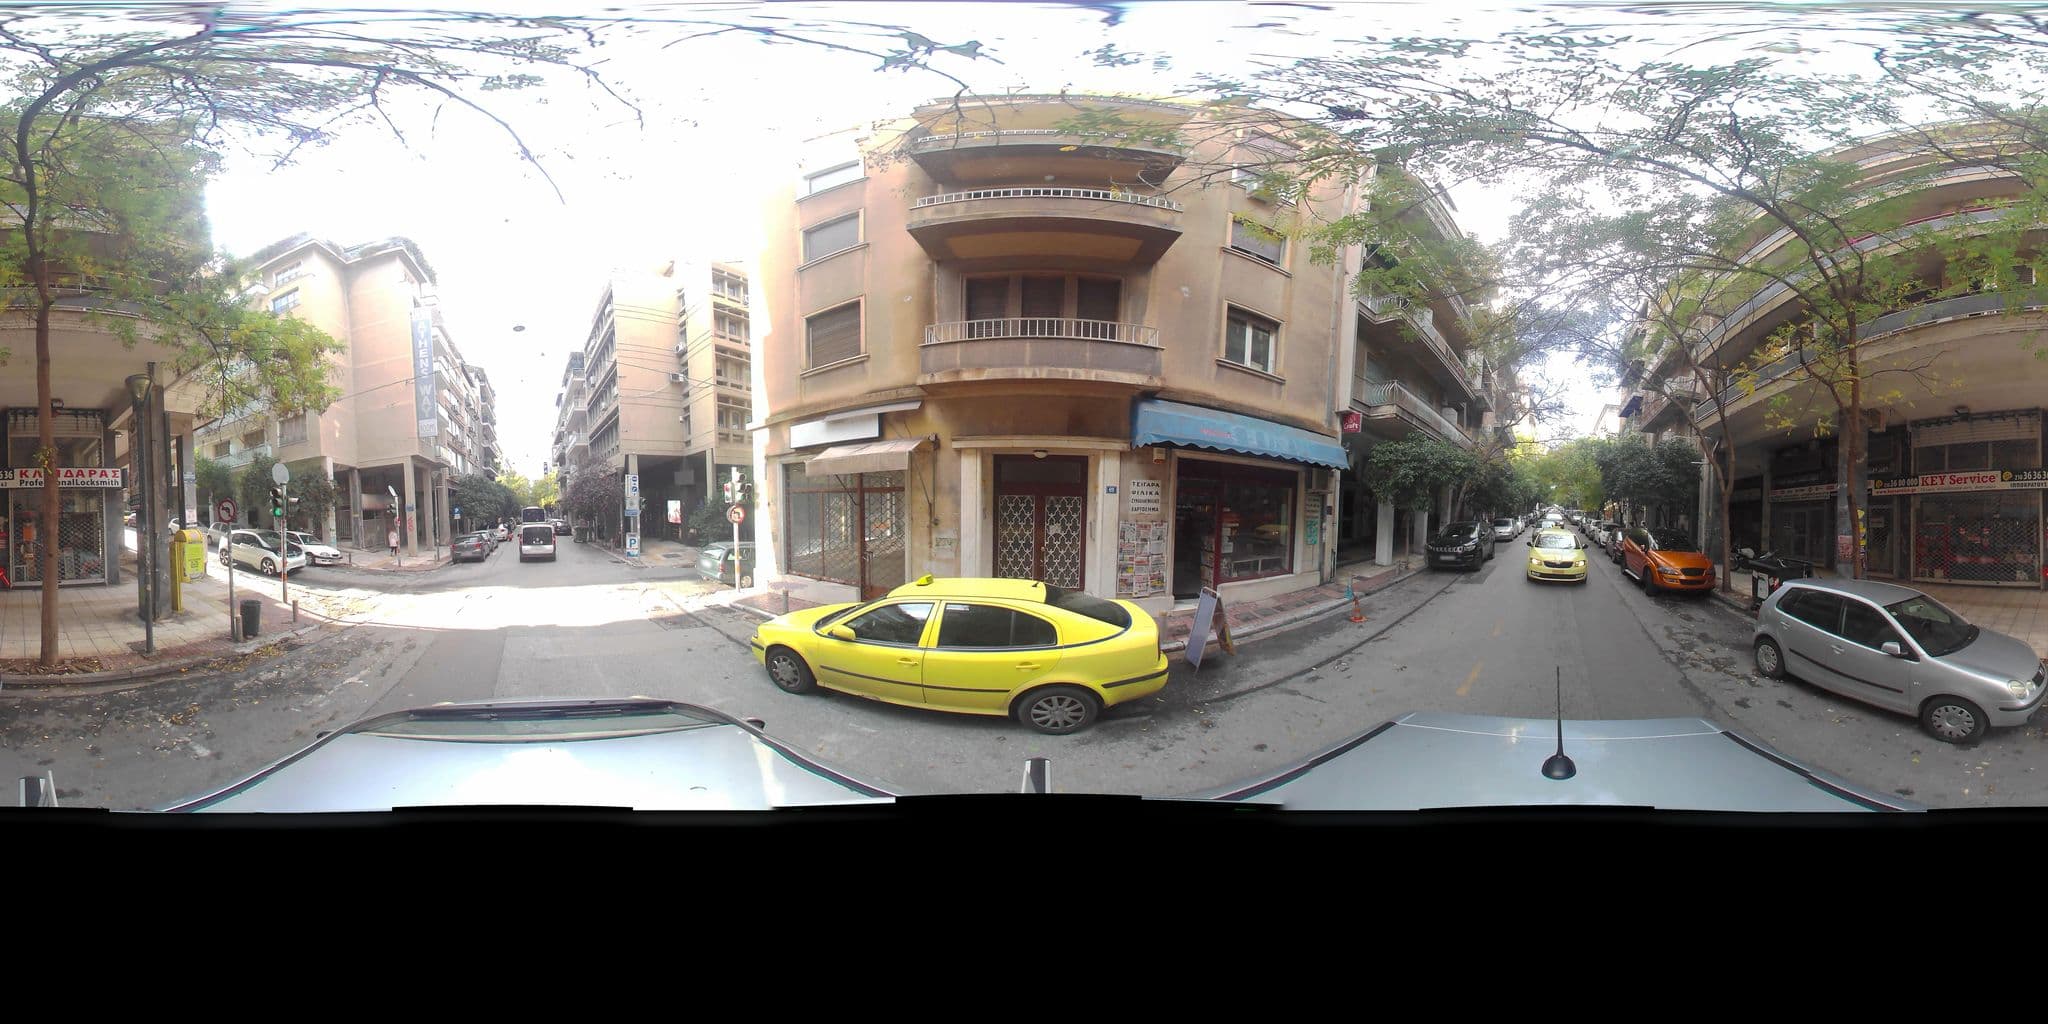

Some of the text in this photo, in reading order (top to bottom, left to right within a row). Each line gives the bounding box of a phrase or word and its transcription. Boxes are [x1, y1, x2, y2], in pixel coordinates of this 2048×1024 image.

[20, 470, 119, 478] ΚΛΙΔΑΡΑΣ
[1921, 473, 1996, 487] KEY Service
